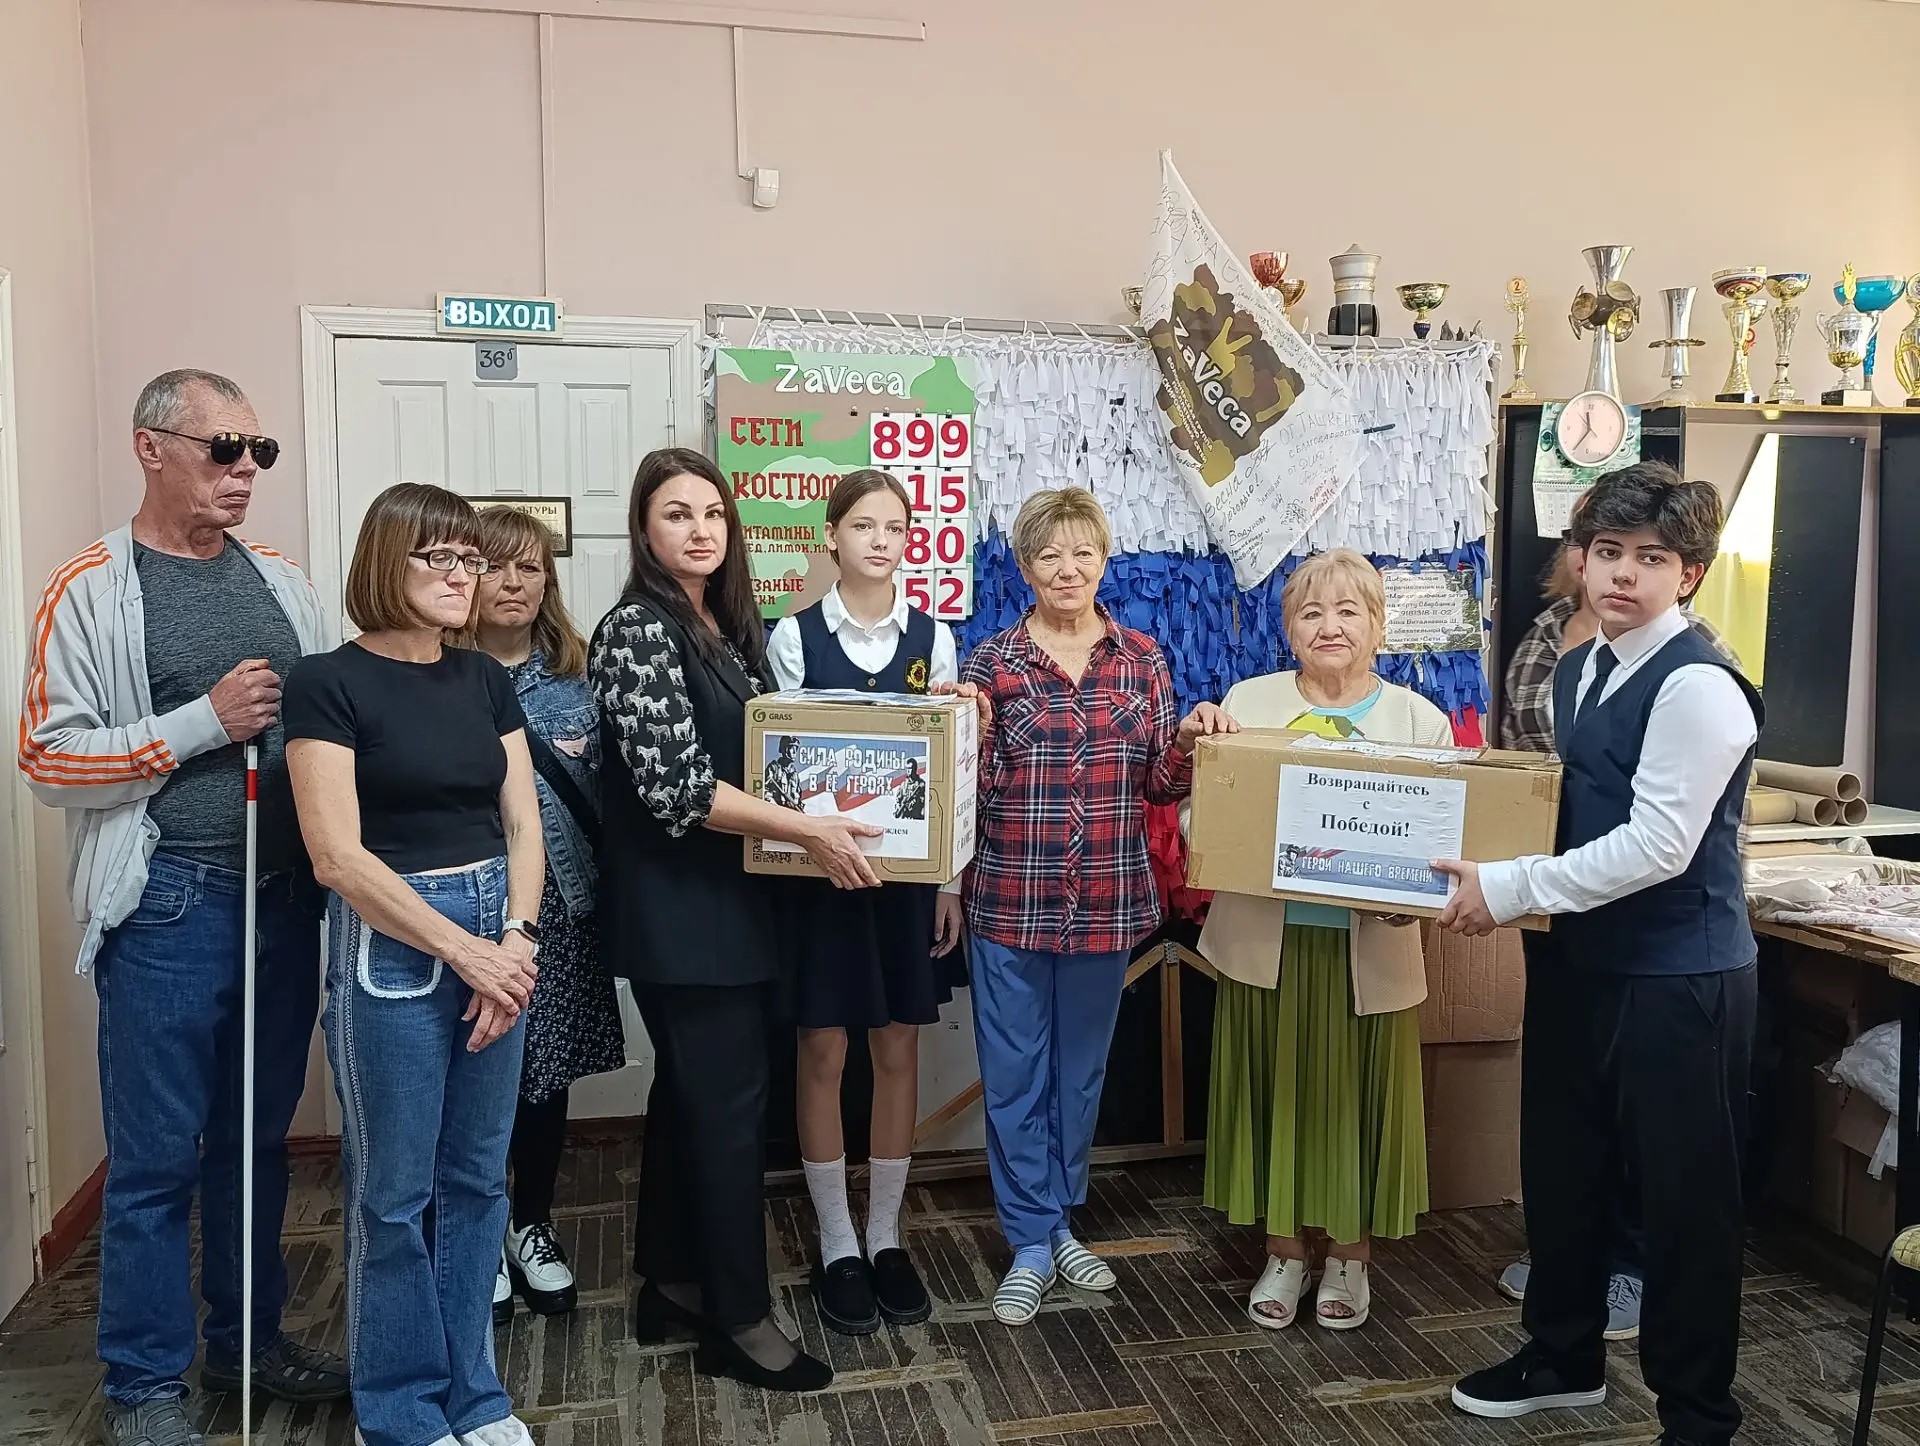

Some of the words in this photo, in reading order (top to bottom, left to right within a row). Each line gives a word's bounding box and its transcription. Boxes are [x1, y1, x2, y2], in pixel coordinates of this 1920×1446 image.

[450, 300, 551, 331] ВЫХОД
[775, 363, 906, 397] ZaVeca
[1173, 315, 1252, 439] ZaVeca
[730, 417, 804, 447] СЕТИ
[873, 419, 969, 460] 899
[1194, 420, 1214, 452] ГРУППА
[732, 472, 848, 501] КОСТЮМ
[907, 473, 967, 514] 15
[743, 525, 816, 540] ИТАМИНЫ
[904, 526, 966, 565] 80
[751, 578, 805, 593] ЗАНЫЕ
[905, 577, 964, 615] 52
[768, 713, 793, 721] GRASS
[799, 746, 837, 767] СИЛА
[845, 748, 906, 774] РОДИНЫ
[809, 774, 818, 792] В
[846, 775, 894, 796] ГЕРОЯХ
[1307, 772, 1430, 797] Возвращайтесь
[1362, 800, 1370, 810] с
[1321, 813, 1410, 838] Победой!
[1301, 856, 1333, 872] ГЕРОИ
[1337, 859, 1382, 878] НАШЕГО
[1388, 866, 1433, 884] ВРЕМЕНИ
